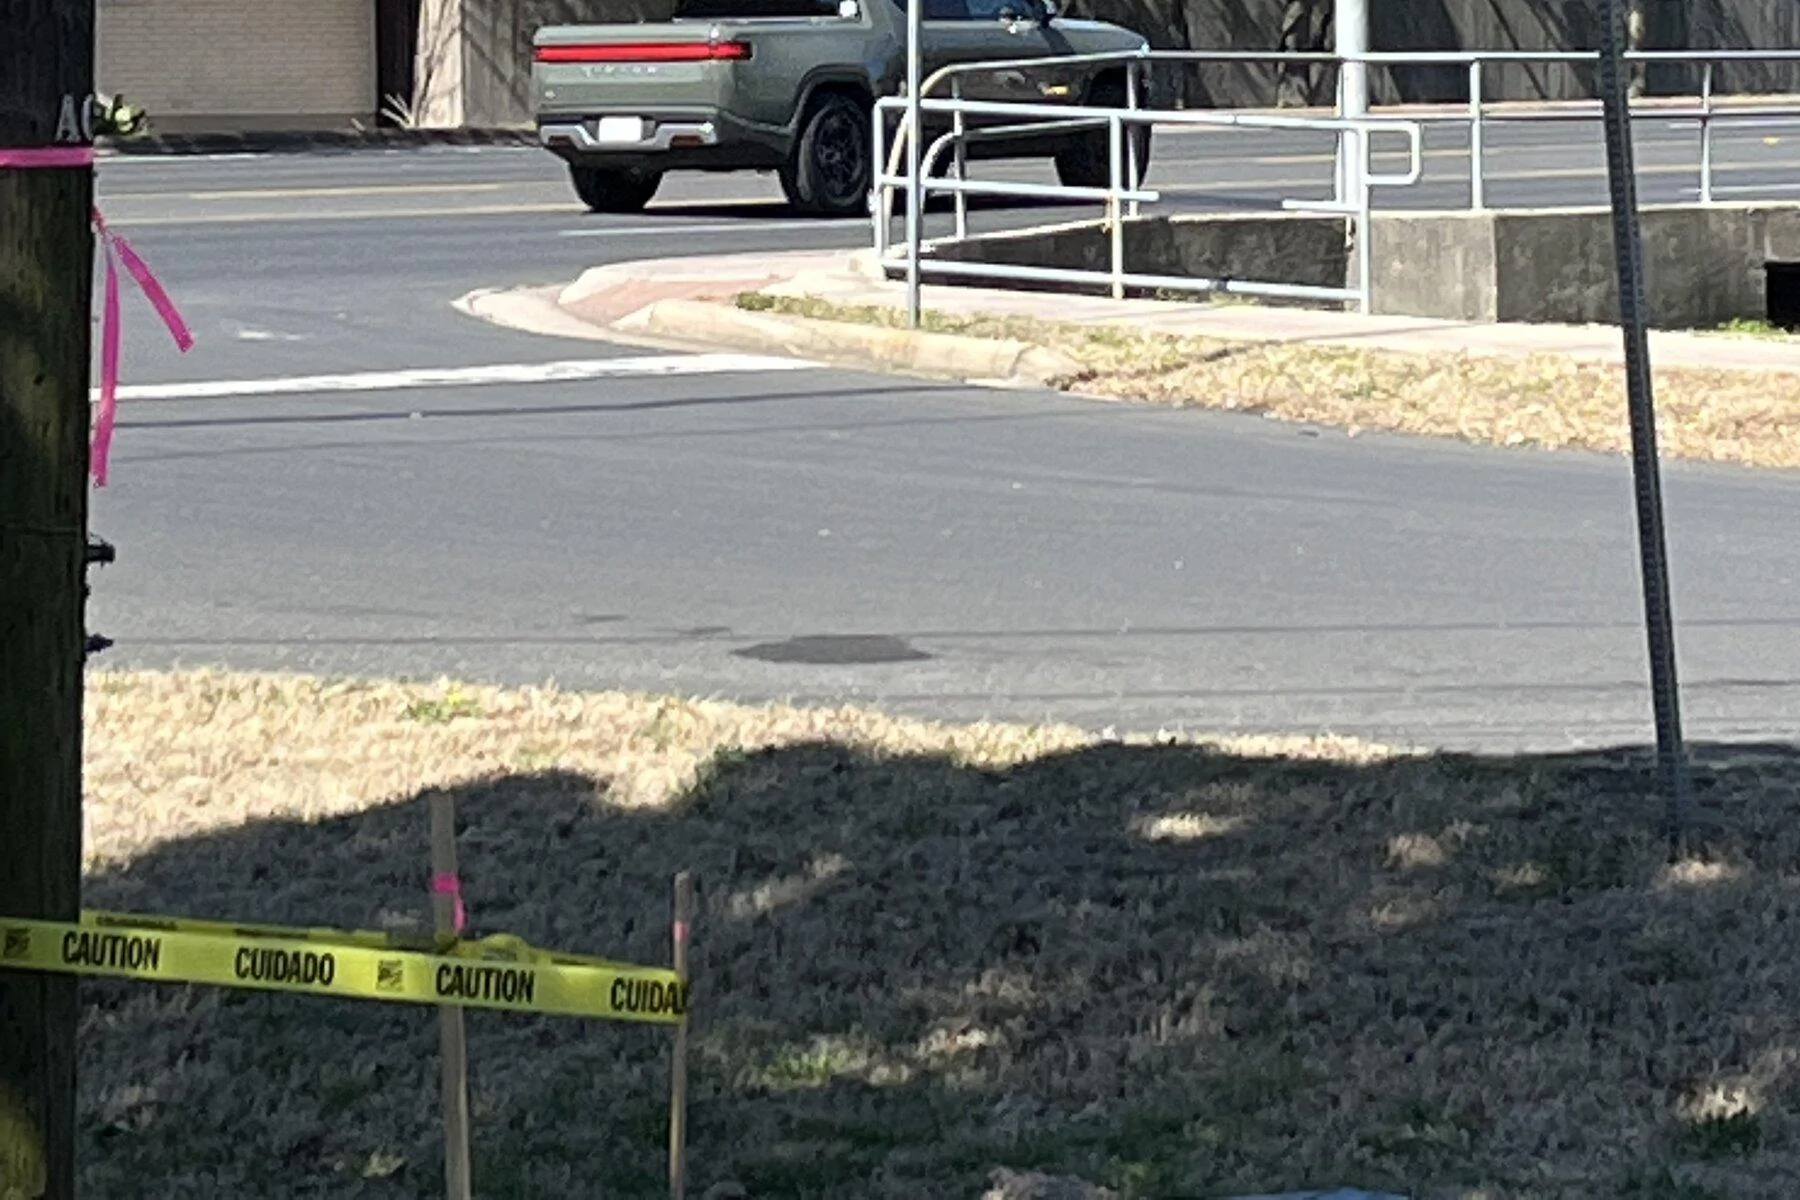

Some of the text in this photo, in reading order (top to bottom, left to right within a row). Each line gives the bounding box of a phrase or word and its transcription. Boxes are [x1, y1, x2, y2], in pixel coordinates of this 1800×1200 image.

[62, 930, 162, 971] CAUTION
[235, 947, 335, 986] CUIDADO
[436, 963, 536, 1004] CAUTION
